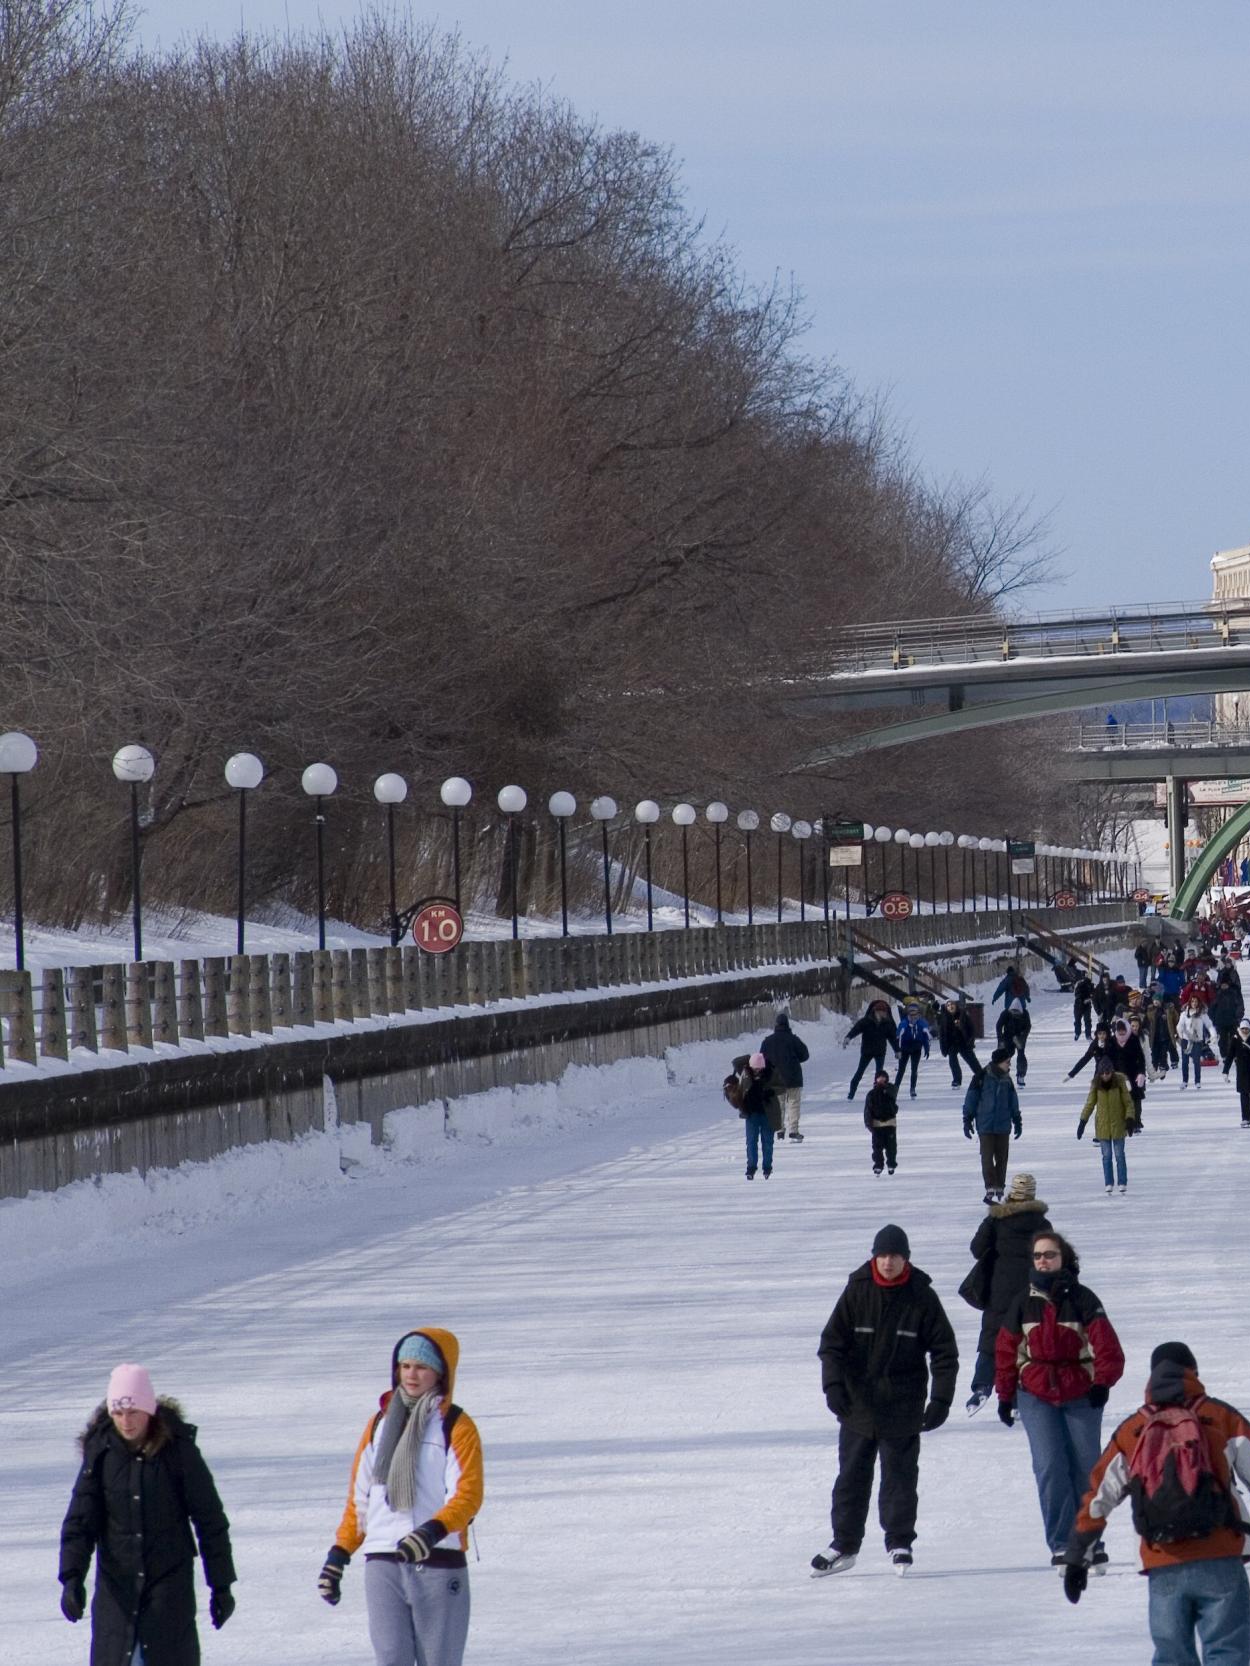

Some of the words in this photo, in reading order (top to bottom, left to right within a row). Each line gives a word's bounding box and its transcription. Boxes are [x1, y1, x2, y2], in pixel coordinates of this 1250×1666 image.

[431, 910, 445, 918] KM
[884, 902, 909, 914] 0.8
[421, 919, 457, 942] 1.0
